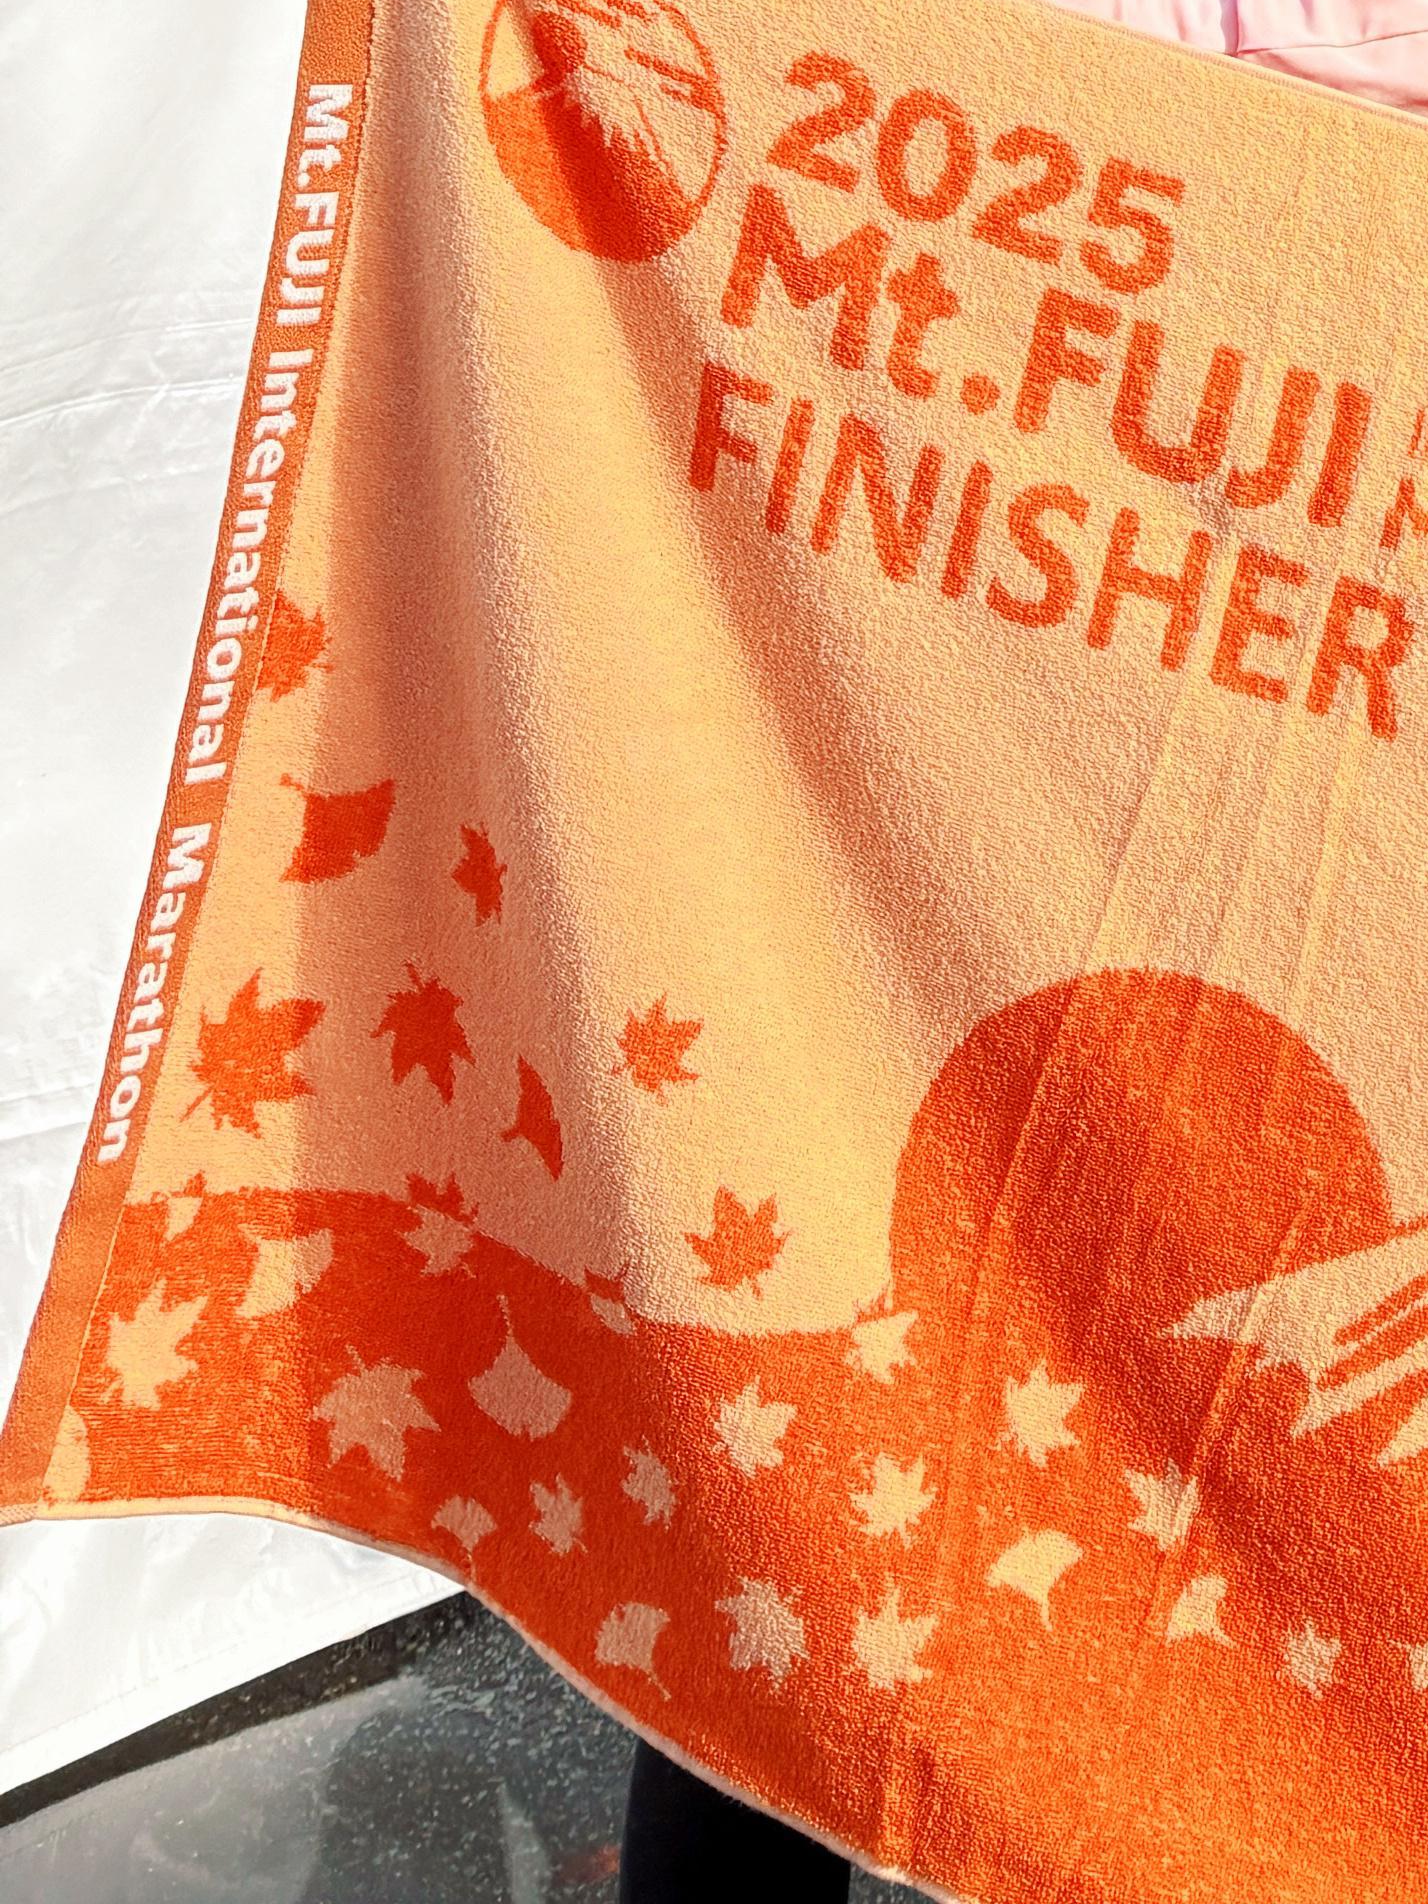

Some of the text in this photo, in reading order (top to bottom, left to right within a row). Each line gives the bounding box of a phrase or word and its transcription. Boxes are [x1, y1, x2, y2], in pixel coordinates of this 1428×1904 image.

[766, 50, 1187, 297] 2025
[719, 183, 1374, 530] Mt.FUJI
[184, 349, 311, 788] International
[689, 360, 1416, 742] FINISHER
[97, 821, 213, 1163] Marathon
